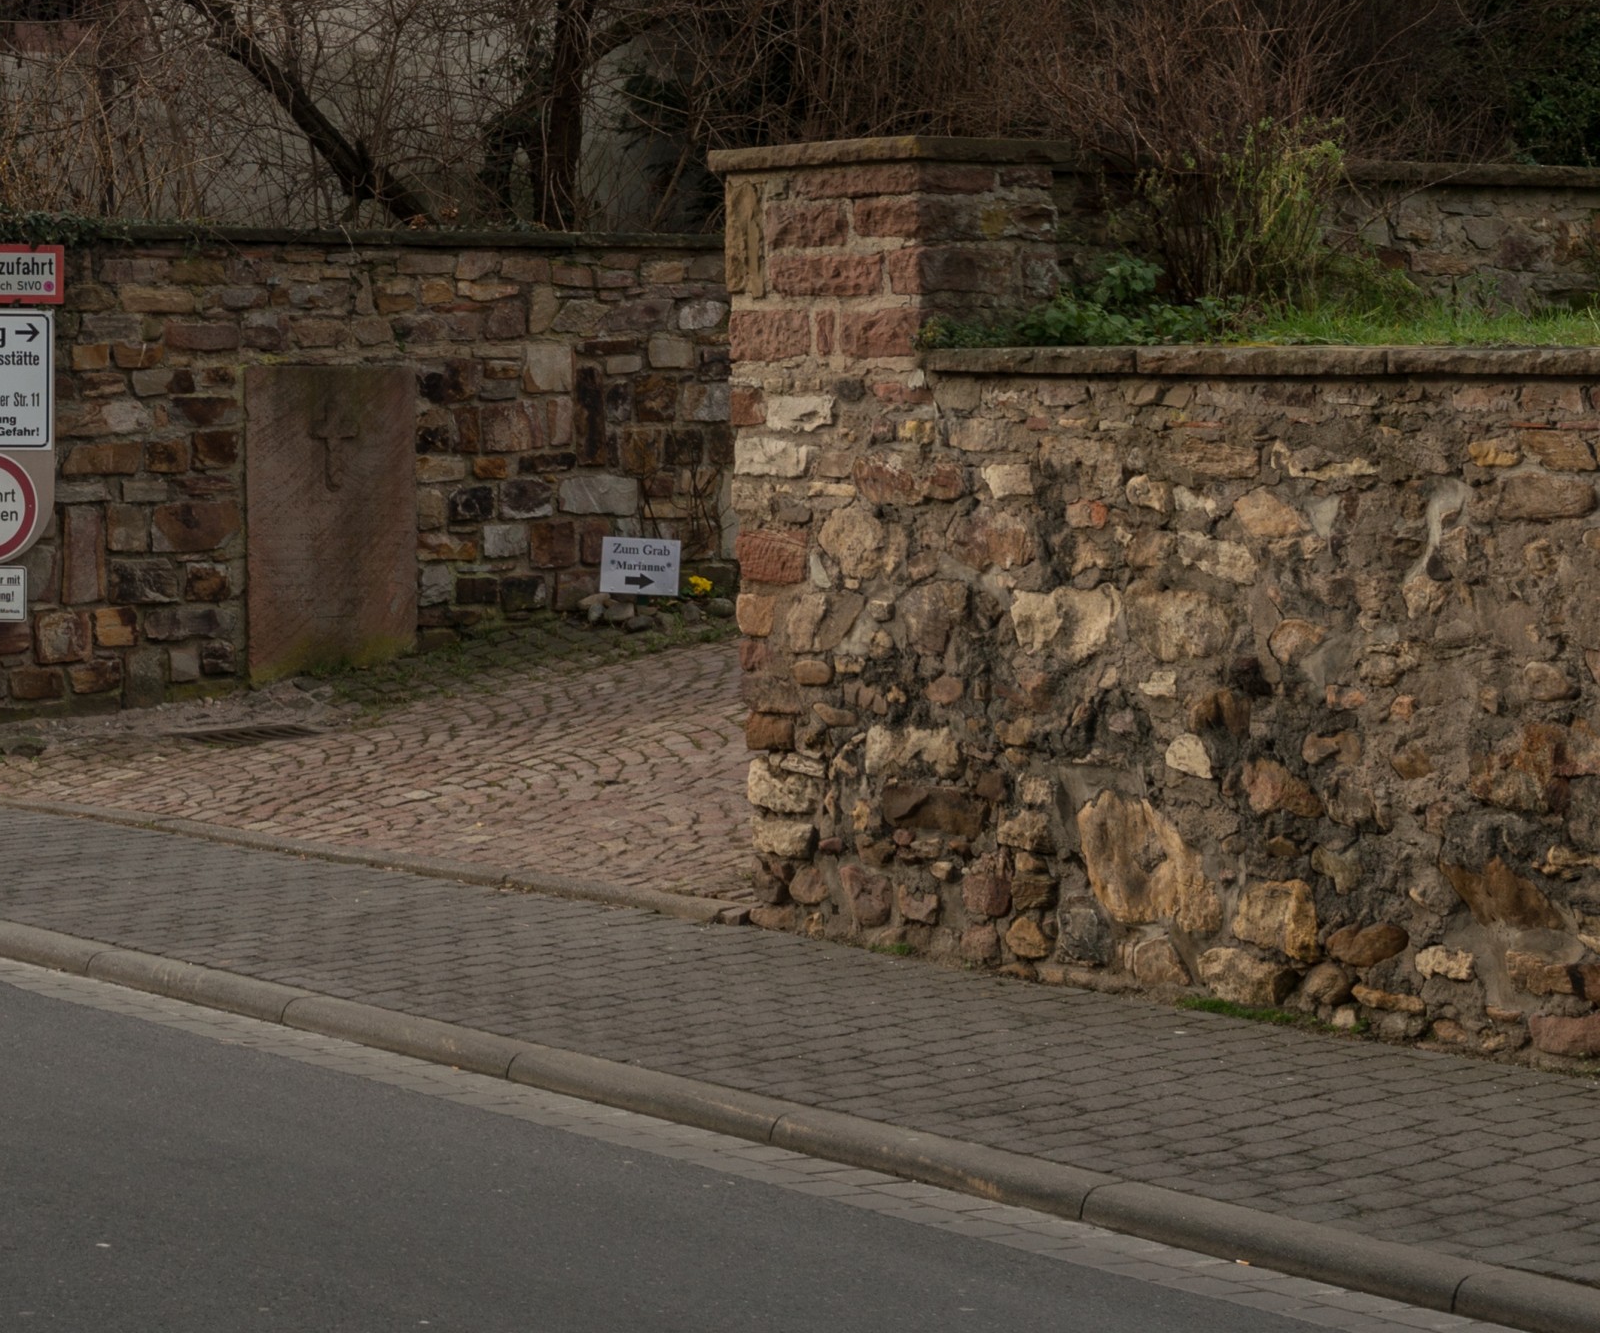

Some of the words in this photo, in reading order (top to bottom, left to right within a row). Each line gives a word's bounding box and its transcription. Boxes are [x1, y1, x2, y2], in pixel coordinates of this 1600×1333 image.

[17, 281, 42, 291] StVO
[13, 392, 28, 407] Str.
[31, 392, 40, 407] 11
[613, 543, 639, 555] Zum
[642, 544, 671, 556] Grab
[7, 575, 21, 585] mit
